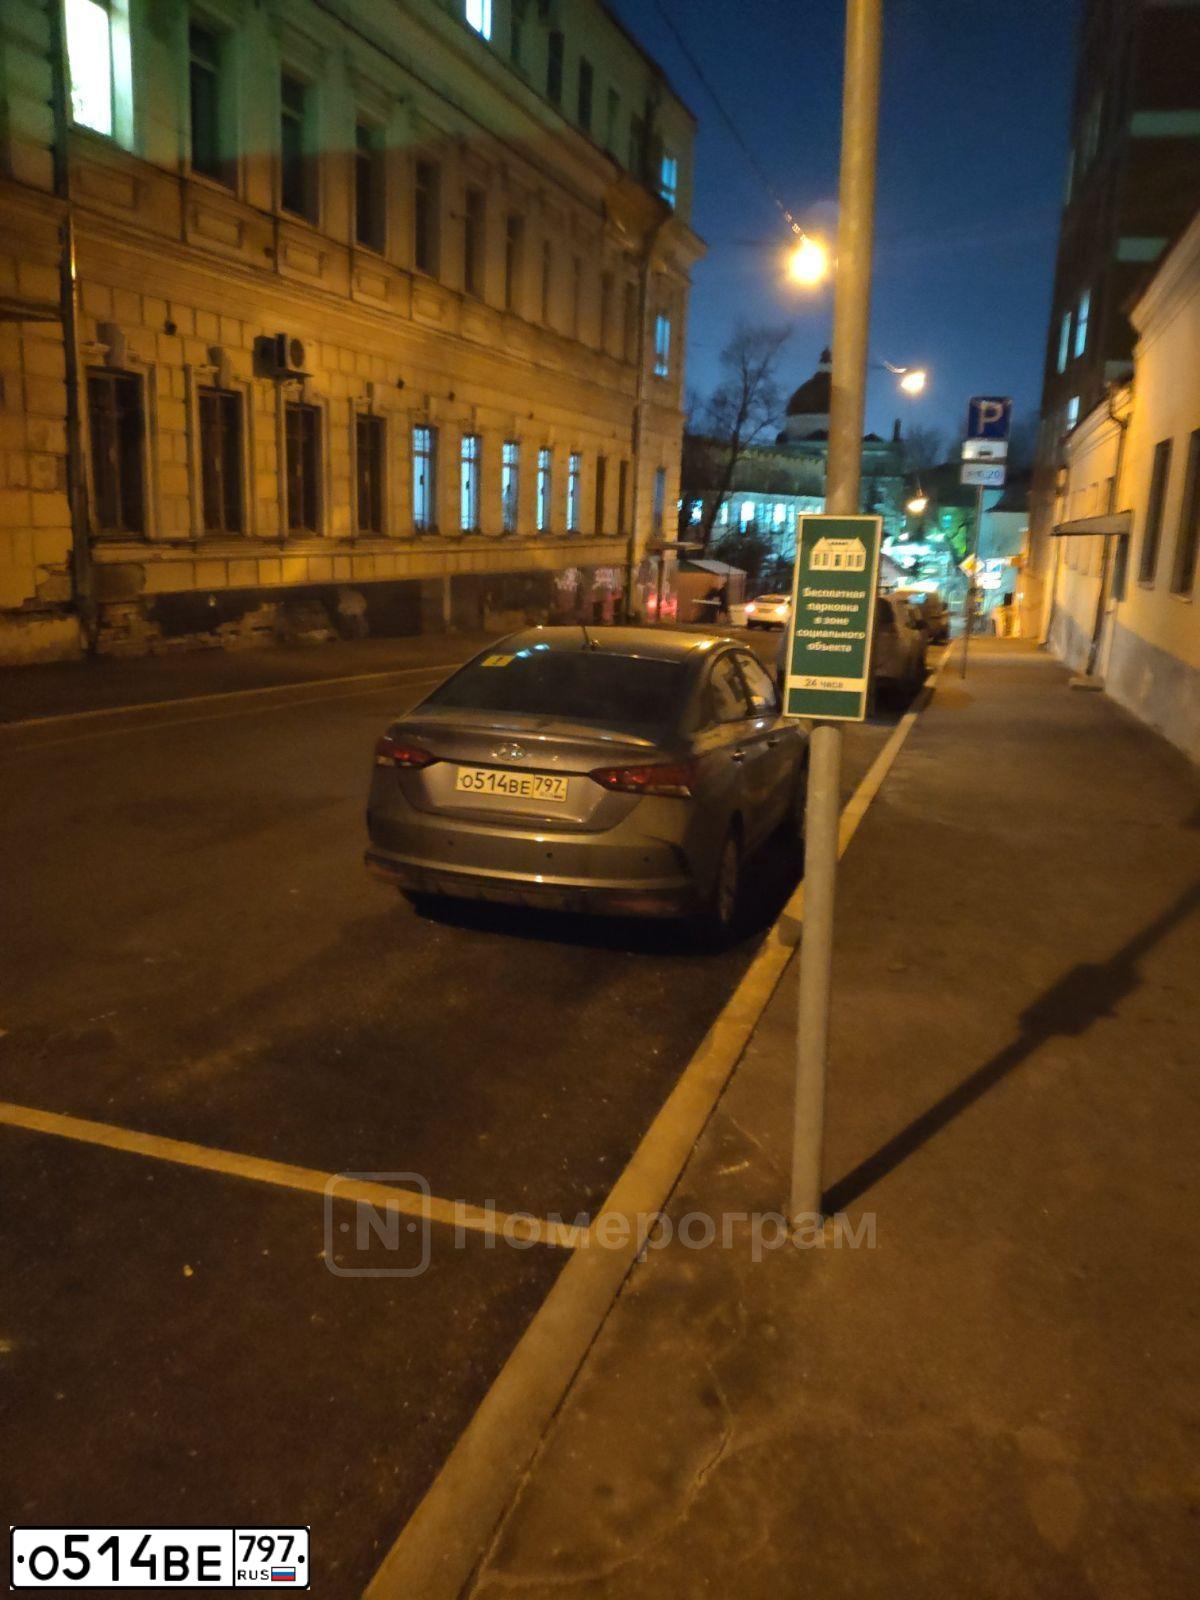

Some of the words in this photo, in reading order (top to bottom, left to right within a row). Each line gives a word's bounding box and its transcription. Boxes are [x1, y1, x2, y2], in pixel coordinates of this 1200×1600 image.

[978, 400, 1004, 434] P
[802, 587, 866, 599] Бесплатная
[805, 602, 859, 613] парковка
[813, 617, 822, 625] в
[823, 617, 849, 626] зоне
[796, 629, 866, 640] социального
[806, 642, 852, 653] объекта
[804, 679, 817, 688] 24
[535, 777, 562, 793] 797
